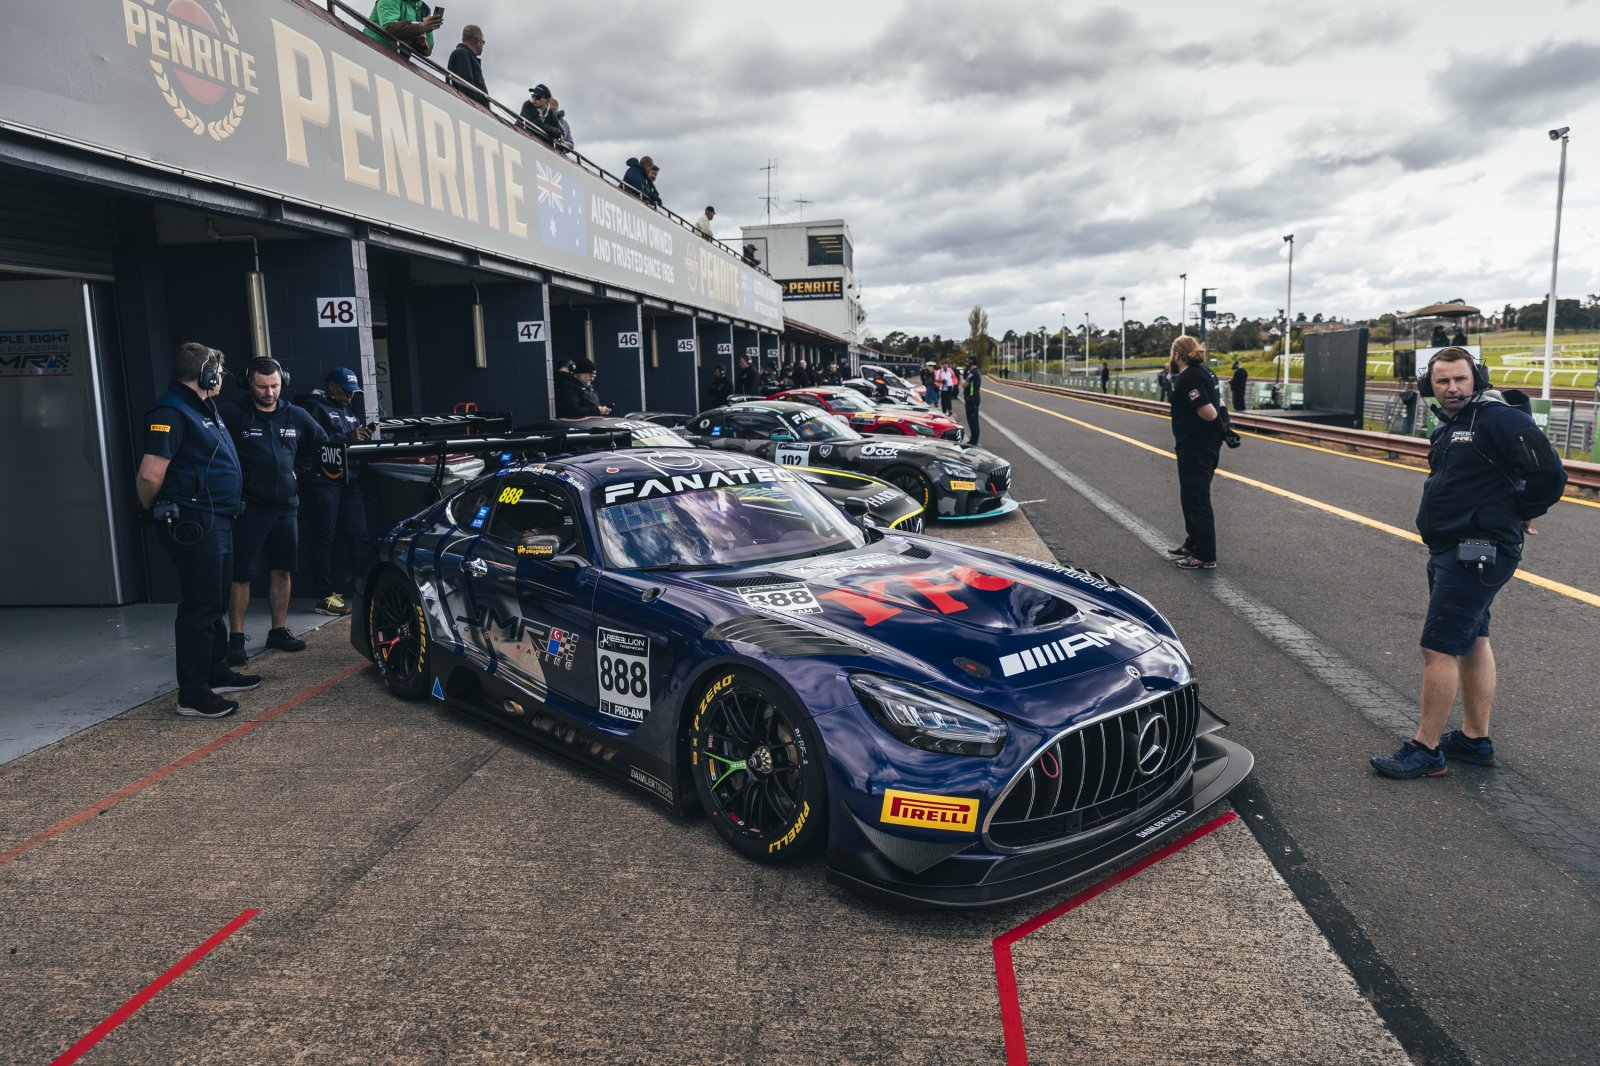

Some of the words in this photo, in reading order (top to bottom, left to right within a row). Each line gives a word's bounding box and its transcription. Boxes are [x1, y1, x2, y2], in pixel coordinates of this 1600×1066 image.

[123, 0, 259, 95] PENRITE
[271, 17, 528, 239] PENRITE
[592, 194, 647, 244] AUSTRALIAN
[649, 223, 673, 256] OWNED
[593, 236, 610, 261] AND
[611, 241, 644, 274] TRUSTED
[644, 253, 662, 280] SINCE
[700, 248, 740, 306] PENRITE
[789, 280, 840, 293] PENRITE
[320, 299, 354, 324] 48
[29, 334, 70, 343] EIGHT
[520, 323, 542, 340] 47
[620, 333, 638, 347] 46
[679, 341, 693, 350] 45
[718, 344, 731, 353] 44
[747, 348, 759, 356] 43
[768, 349, 779, 357] 42
[320, 444, 343, 467] aws
[780, 454, 802, 466] 102
[499, 486, 523, 504] 888
[605, 468, 798, 504] FANATEC
[747, 590, 815, 607] 888
[606, 634, 646, 647] REBELLION
[1058, 621, 1148, 659] AMG
[599, 654, 648, 698] 888
[699, 674, 736, 715] ZERO
[614, 704, 645, 720] PRO-AM
[889, 795, 972, 825] PIRELLI
[768, 800, 811, 854] PIRELLI
